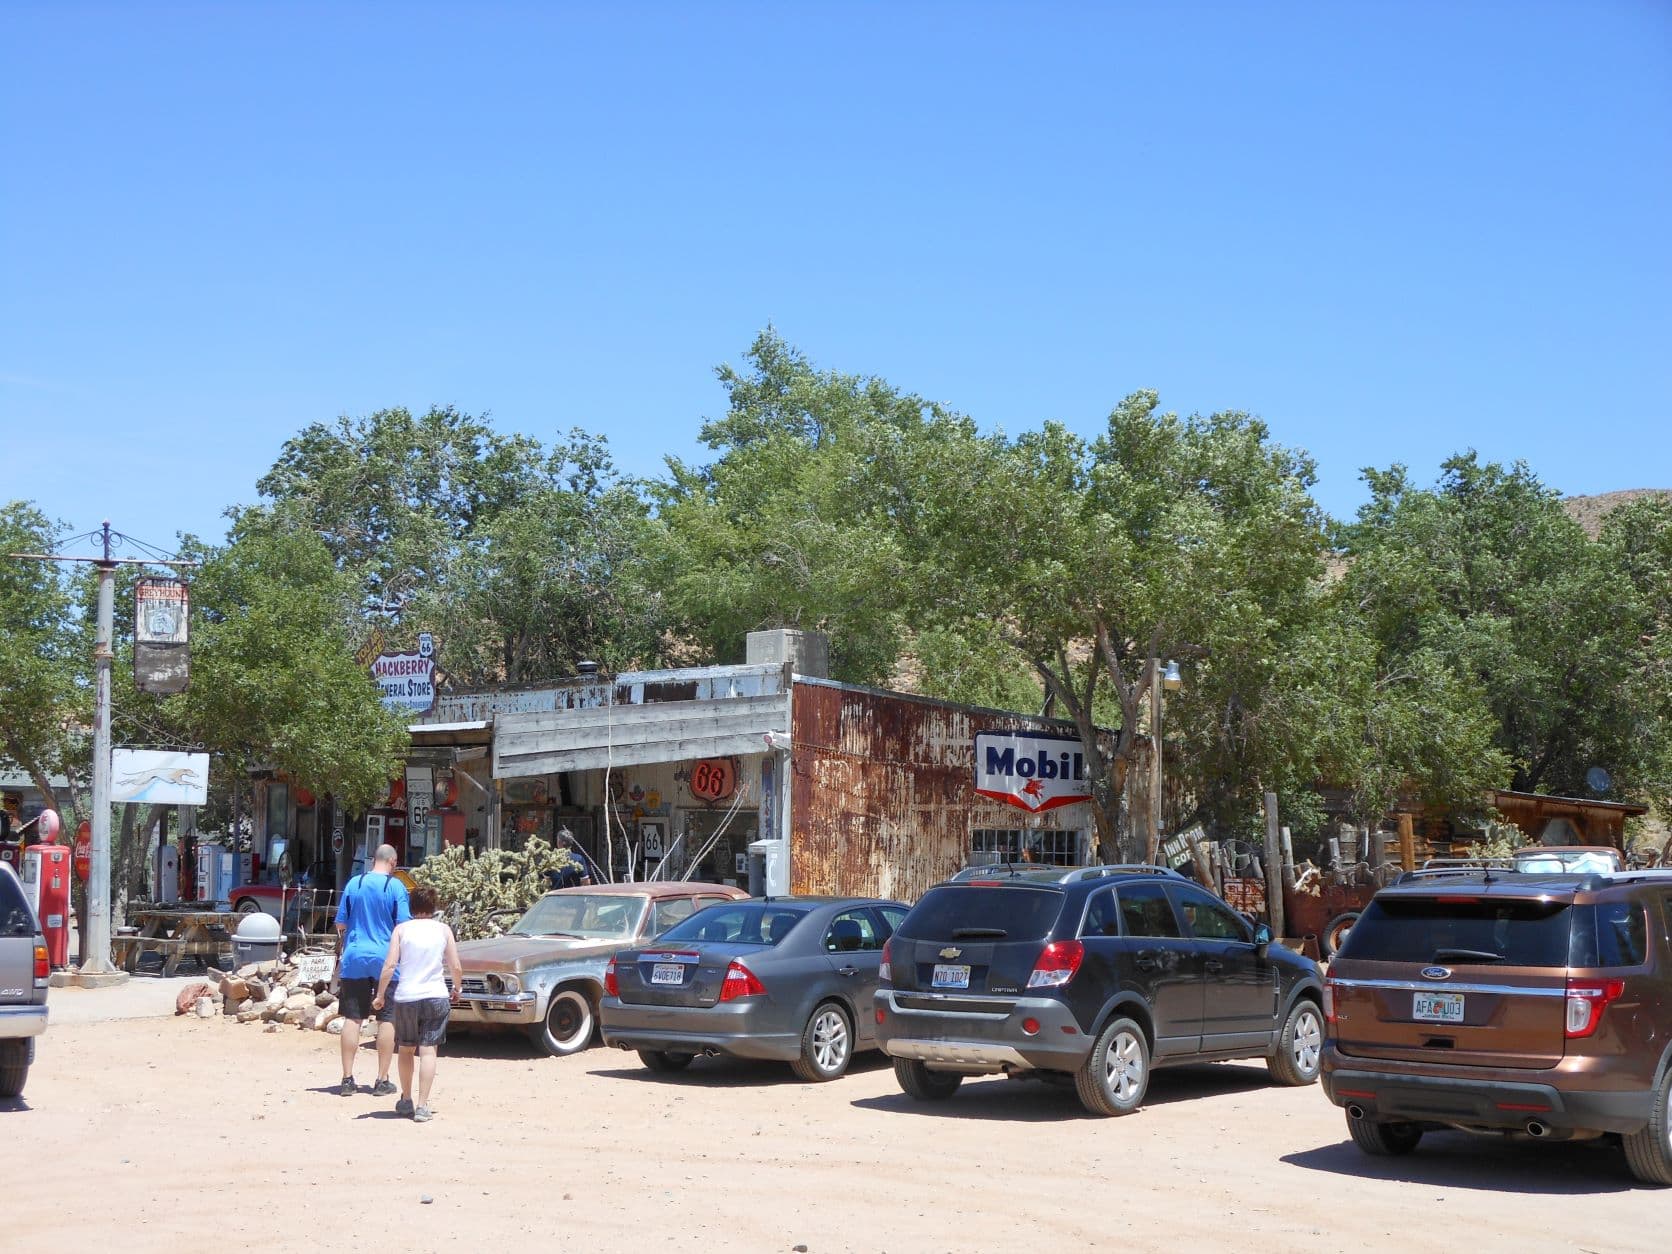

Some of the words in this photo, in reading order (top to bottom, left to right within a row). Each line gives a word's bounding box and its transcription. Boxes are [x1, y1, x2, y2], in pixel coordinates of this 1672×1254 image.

[421, 643, 431, 653] 66
[375, 659, 430, 676] HACKBERRY
[407, 679, 431, 697] STORE
[986, 746, 1083, 780] Mobil
[695, 762, 724, 797] 66
[645, 833, 658, 850] 66
